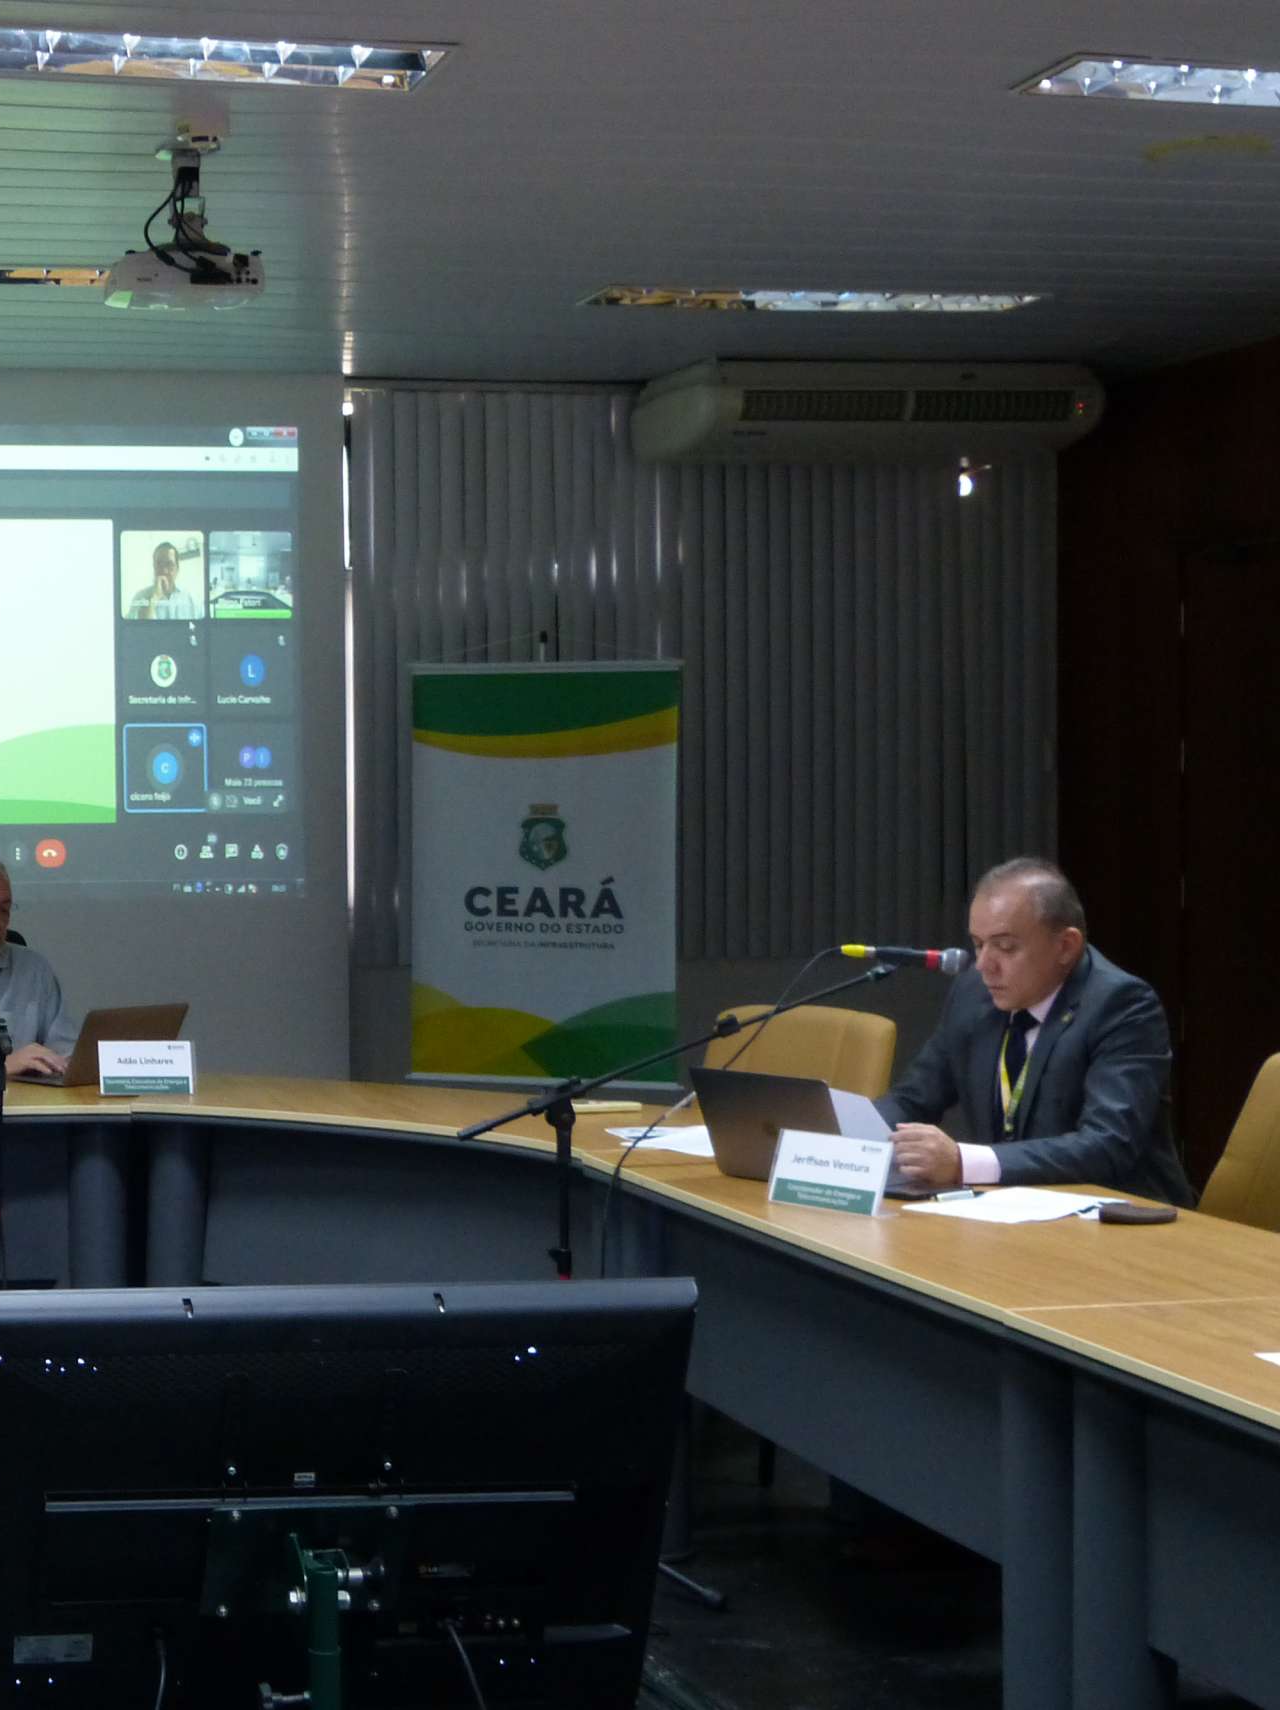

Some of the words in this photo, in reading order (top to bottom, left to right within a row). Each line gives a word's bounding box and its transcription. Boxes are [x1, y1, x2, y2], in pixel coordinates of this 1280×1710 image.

[464, 875, 624, 920] CEARÁ
[464, 920, 536, 933] GOVERNO
[539, 921, 562, 934] DO
[565, 922, 625, 935] ESTADO
[116, 1057, 138, 1065] Adão
[140, 1057, 174, 1065] Linhares
[832, 1159, 870, 1174] Ventura
